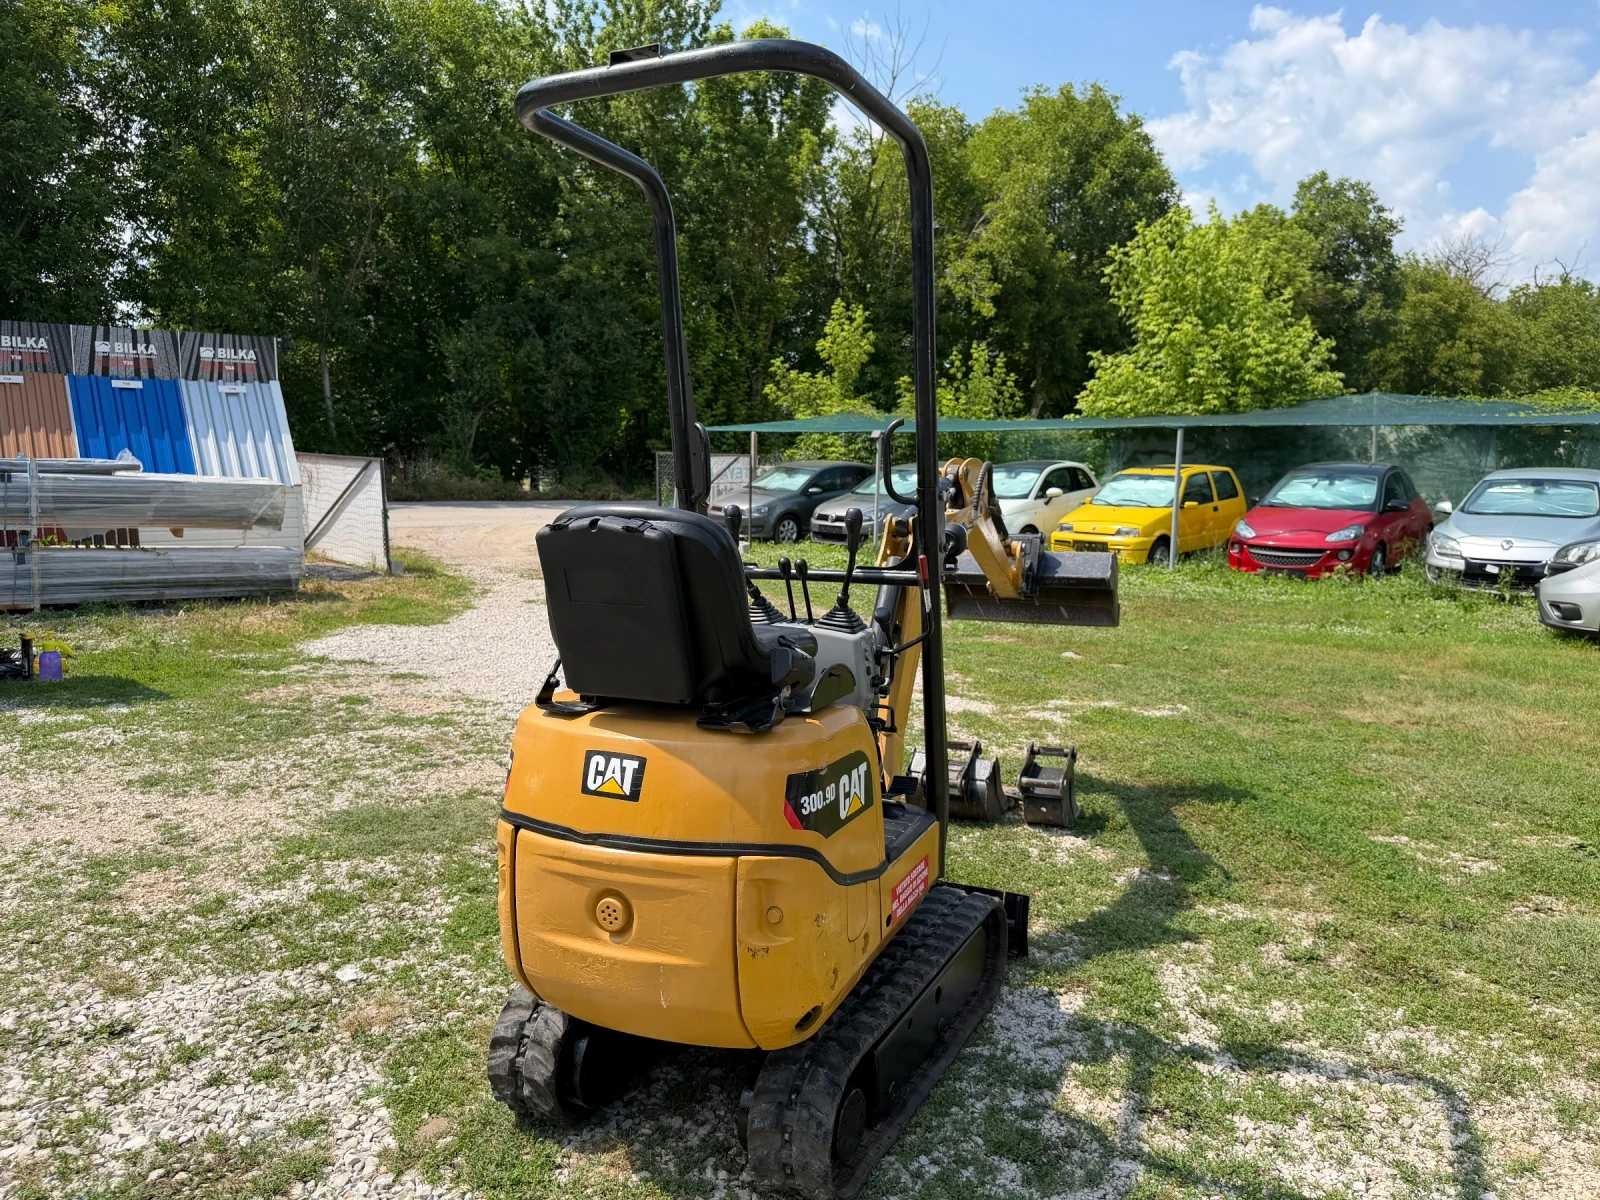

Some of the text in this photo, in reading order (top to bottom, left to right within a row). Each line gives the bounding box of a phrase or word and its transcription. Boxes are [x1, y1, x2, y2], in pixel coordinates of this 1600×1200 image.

[1, 335, 48, 349] BILKA
[114, 341, 157, 355] BILKA
[217, 347, 257, 361] BILKA
[587, 755, 639, 796] CAT
[800, 761, 867, 820] 300.9D CAT
